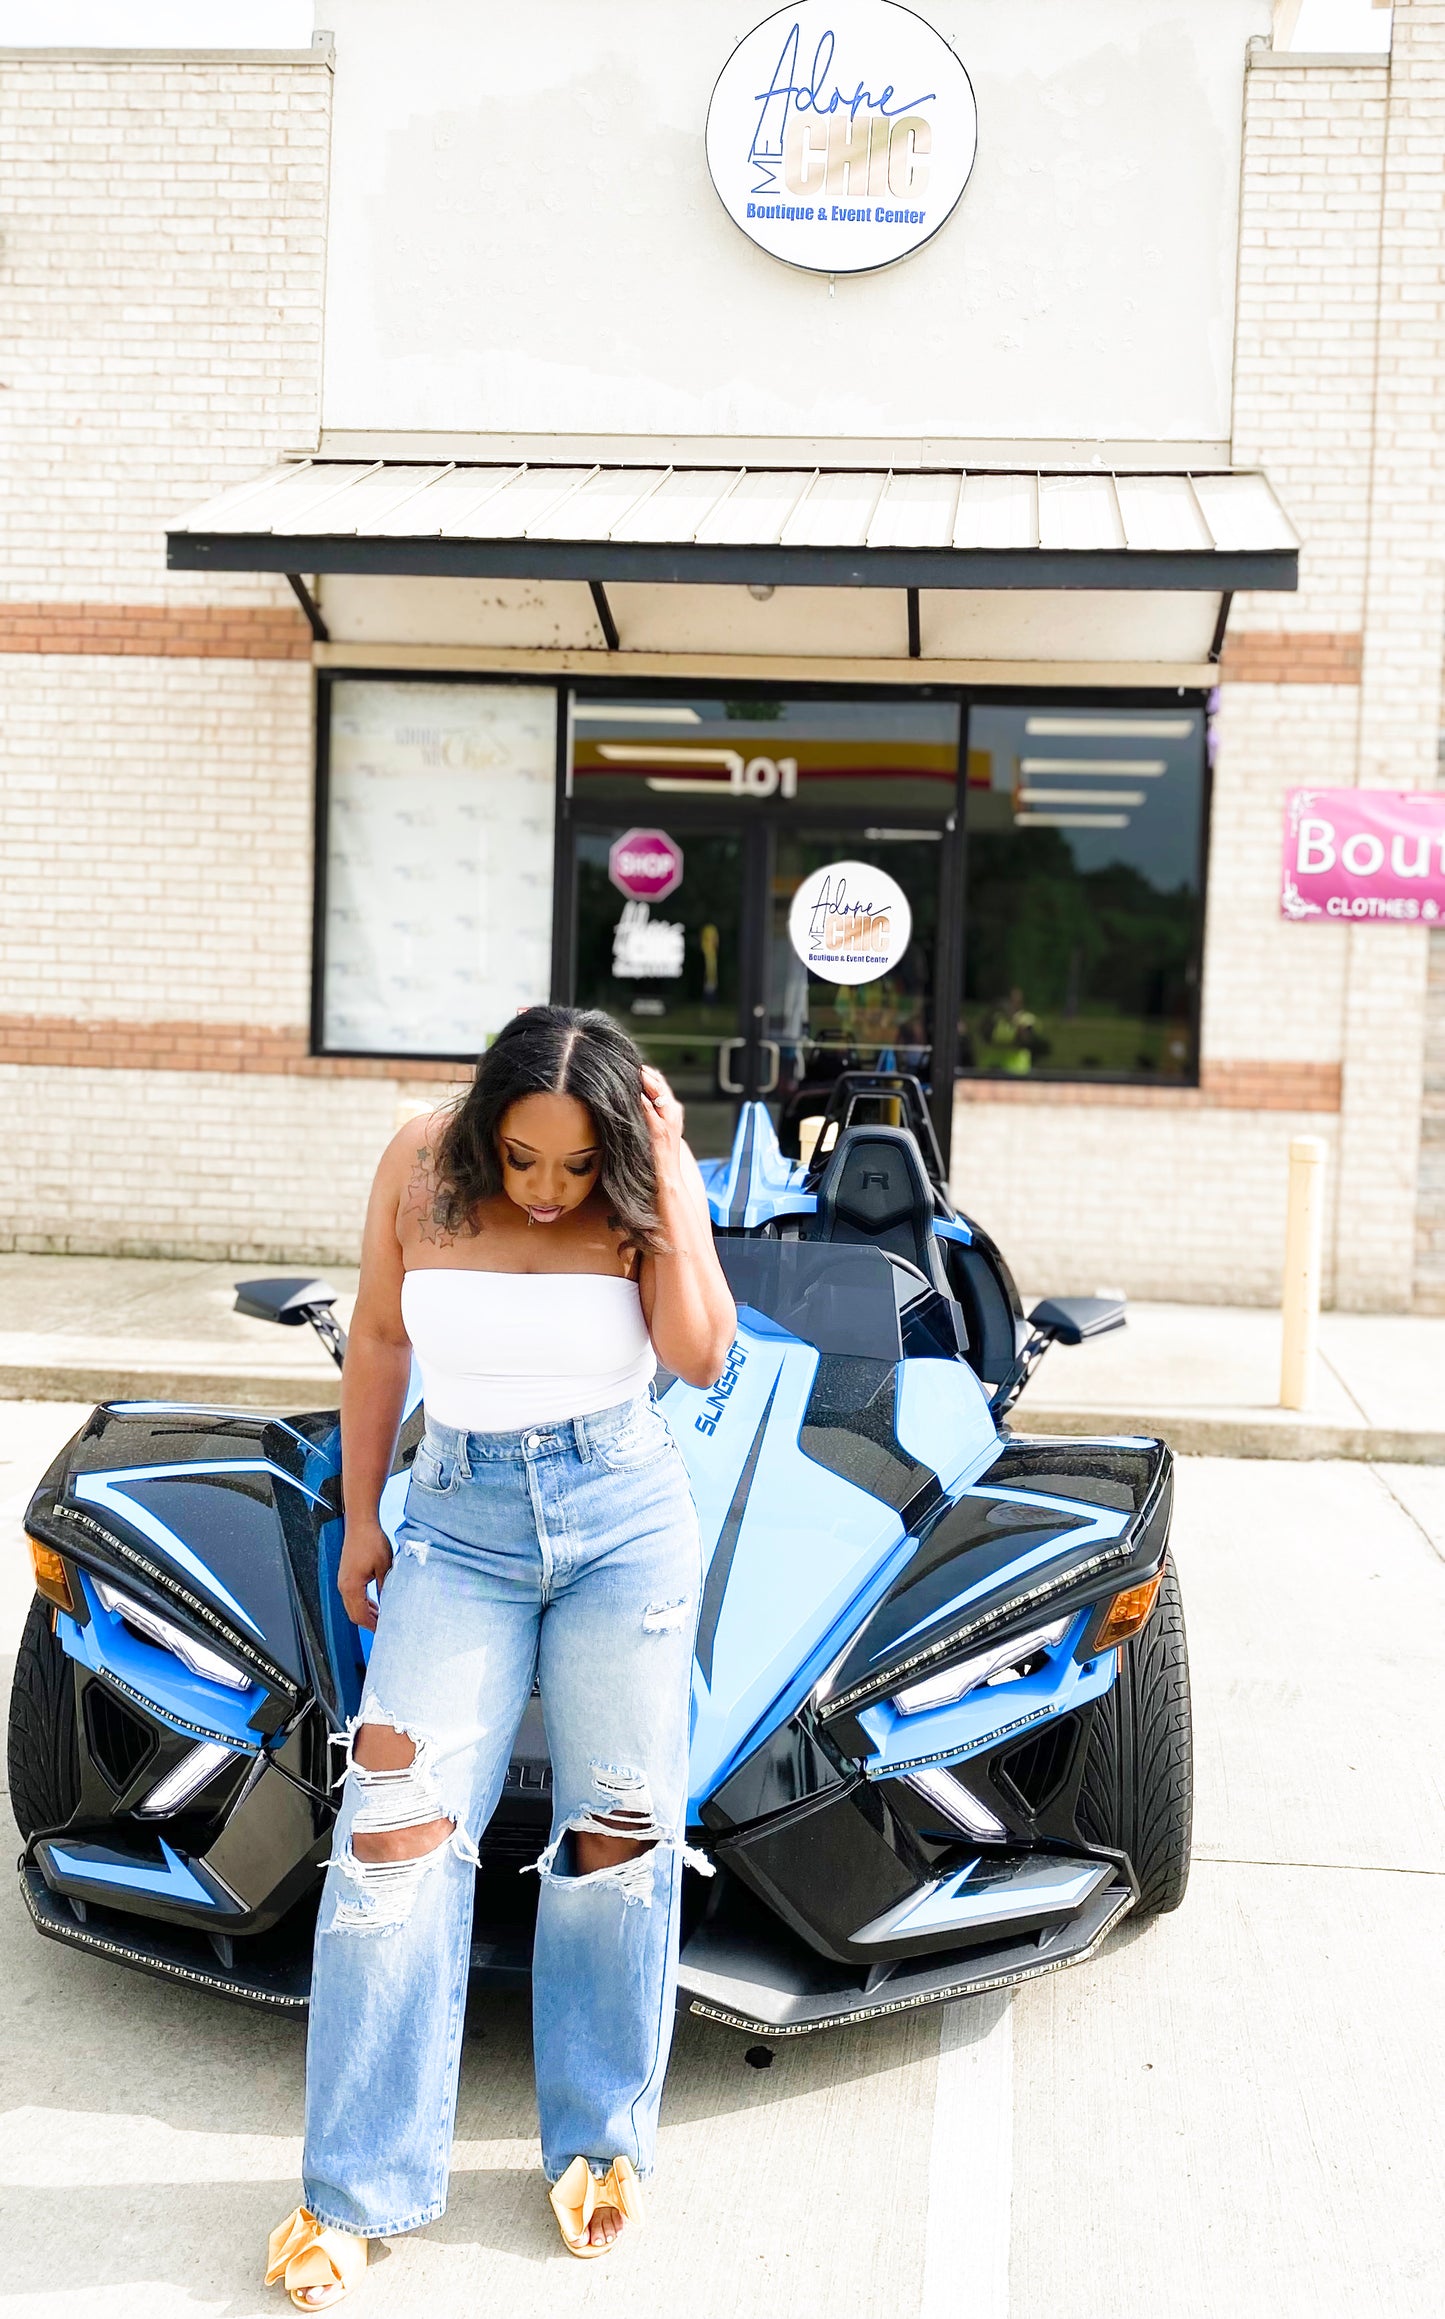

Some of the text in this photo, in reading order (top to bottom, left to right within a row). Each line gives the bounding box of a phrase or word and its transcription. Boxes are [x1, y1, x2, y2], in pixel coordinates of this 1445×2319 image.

[785, 115, 932, 200] CHIC
[746, 202, 927, 225] Boutique & Event Center
[725, 756, 798, 799] 101
[616, 851, 675, 878] SHOP
[1326, 896, 1420, 919] CLOTHES
[825, 915, 890, 953] CHIC
[808, 953, 839, 963] Boutique
[846, 954, 865, 963] Event
[865, 955, 889, 964] Center
[861, 1170, 890, 1190] R
[694, 1340, 749, 1437] SLINGSHOT
